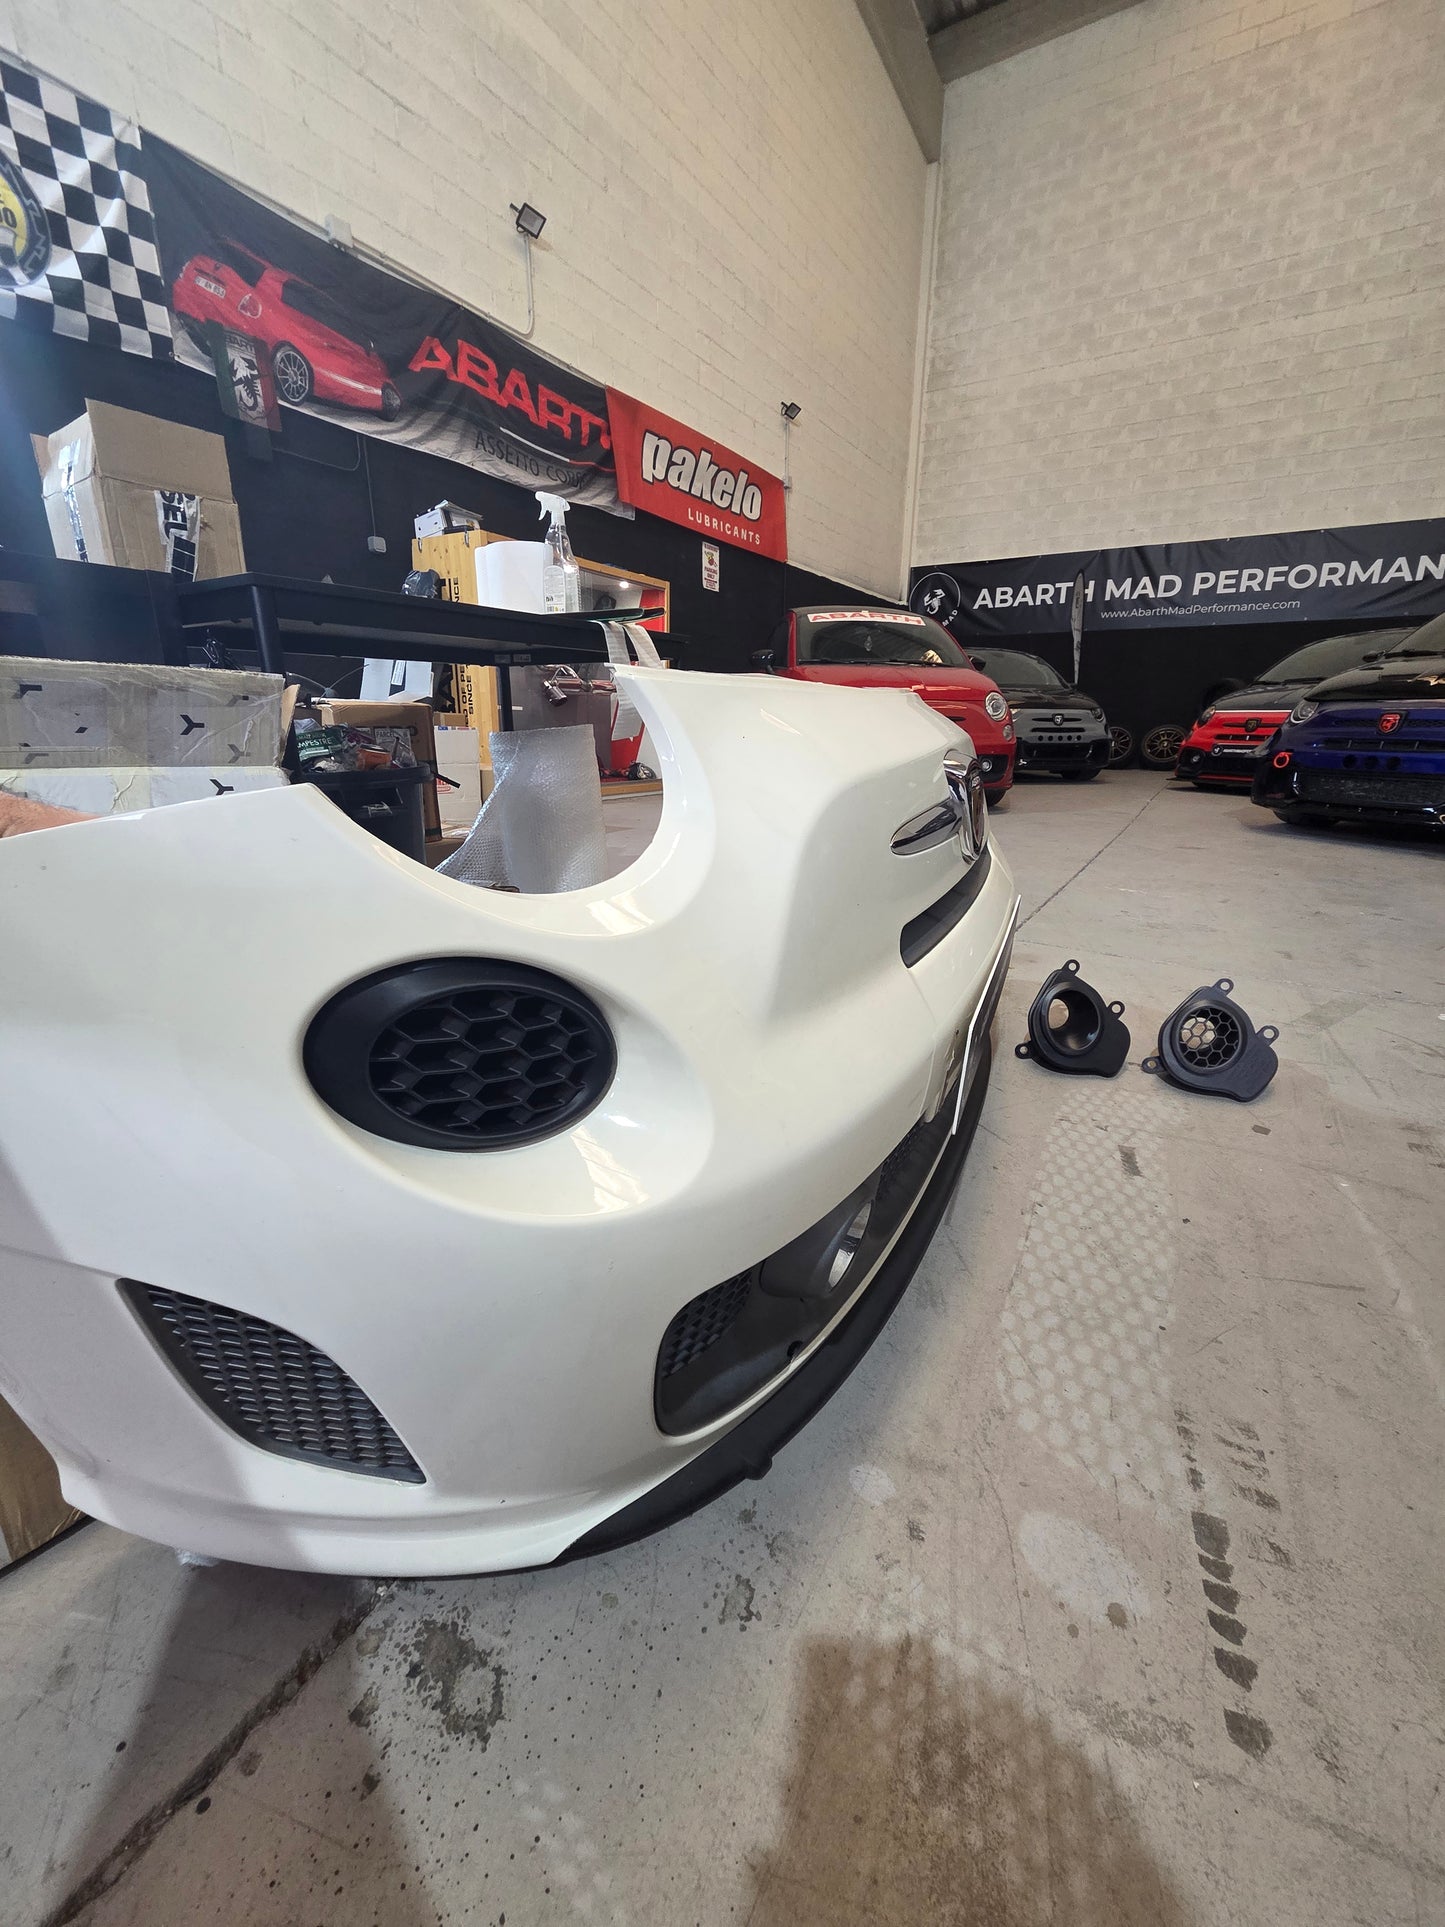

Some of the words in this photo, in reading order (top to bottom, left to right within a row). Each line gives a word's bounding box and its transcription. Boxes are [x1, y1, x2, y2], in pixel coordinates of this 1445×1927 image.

[475, 430, 540, 477] ASSETTO
[641, 430, 762, 521] pakelo
[688, 507, 761, 545] LUBRICANTS
[972, 579, 1095, 610] ABARTH
[1104, 574, 1182, 601] MAD
[1100, 599, 1301, 619] www.AbarthMadPerformance.com
[811, 611, 923, 626] ABARTH
[942, 608, 959, 627] MAD
[466, 675, 474, 715] SINCE
